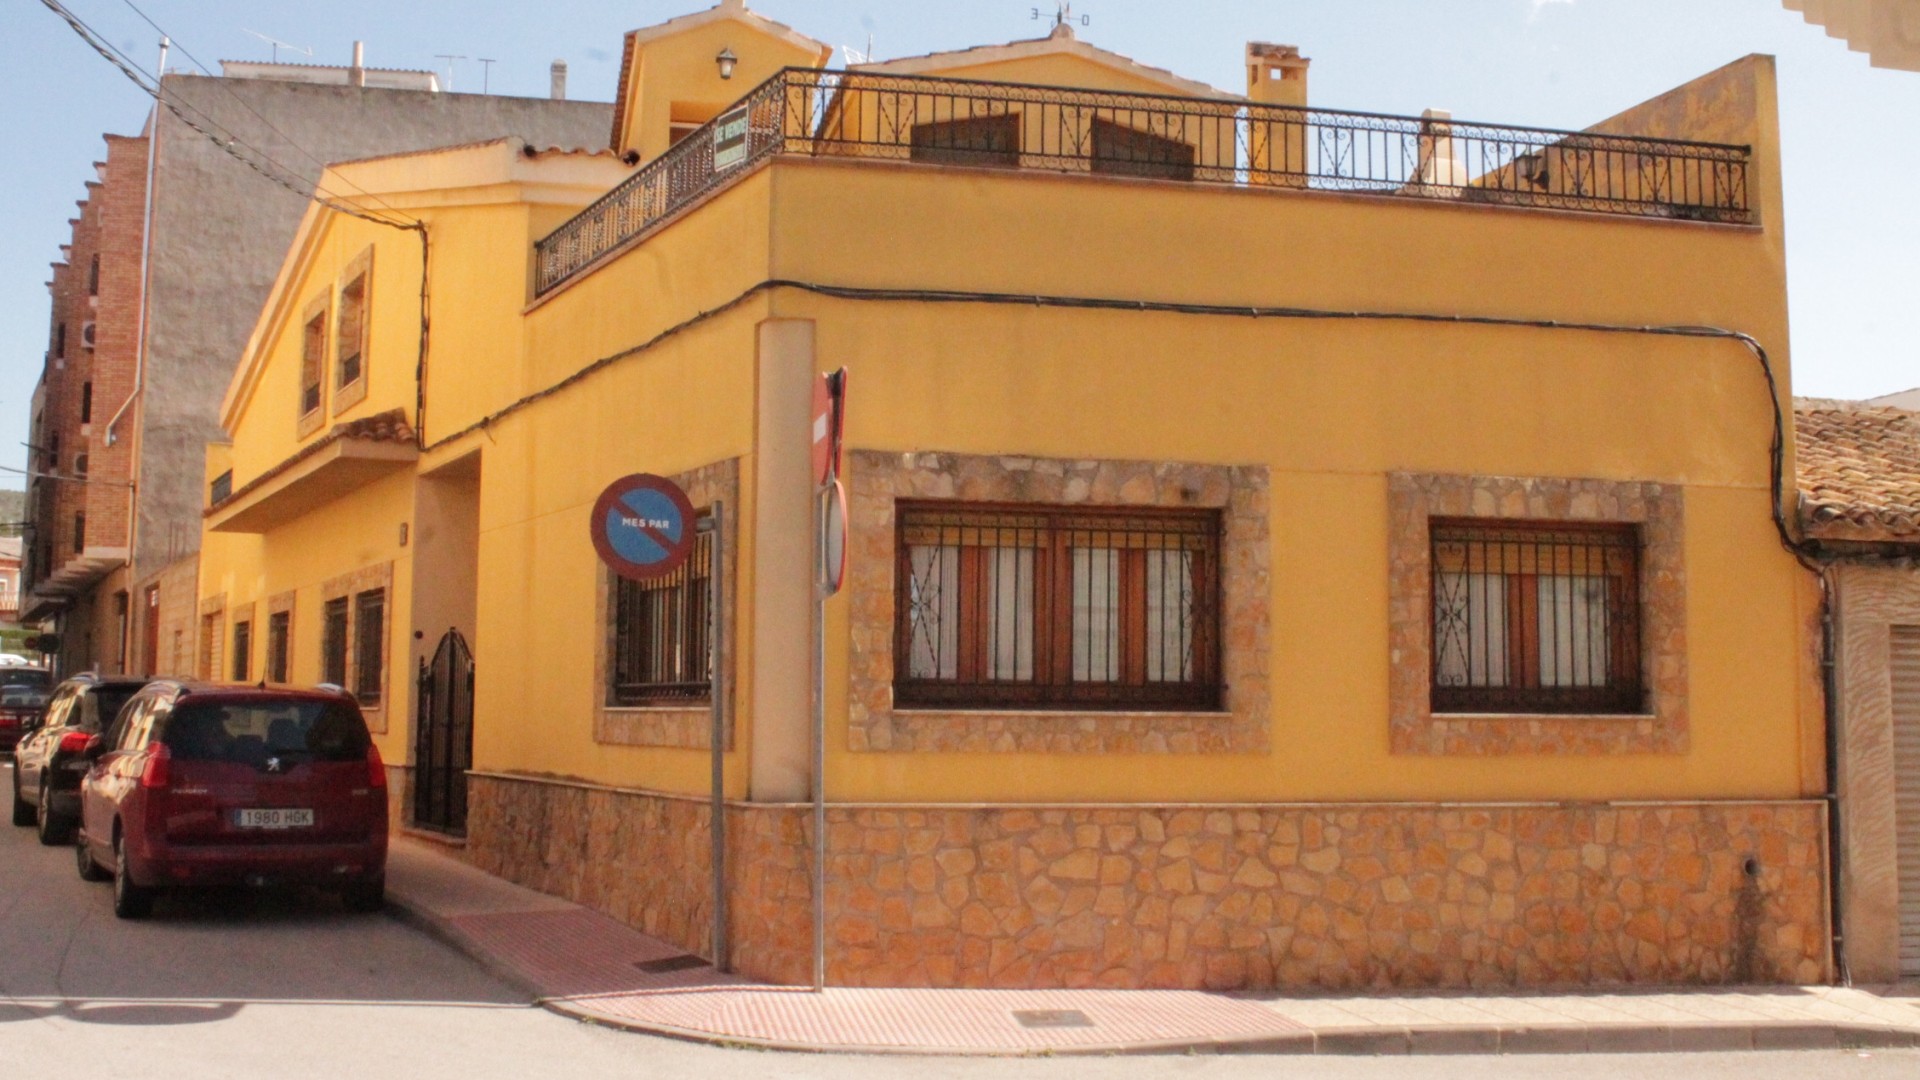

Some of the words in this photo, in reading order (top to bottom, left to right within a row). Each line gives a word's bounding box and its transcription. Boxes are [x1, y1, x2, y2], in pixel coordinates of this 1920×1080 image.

[622, 518, 646, 528] MES
[648, 519, 669, 529] PAR
[247, 811, 280, 824] 1980
[284, 811, 309, 824] HGK
